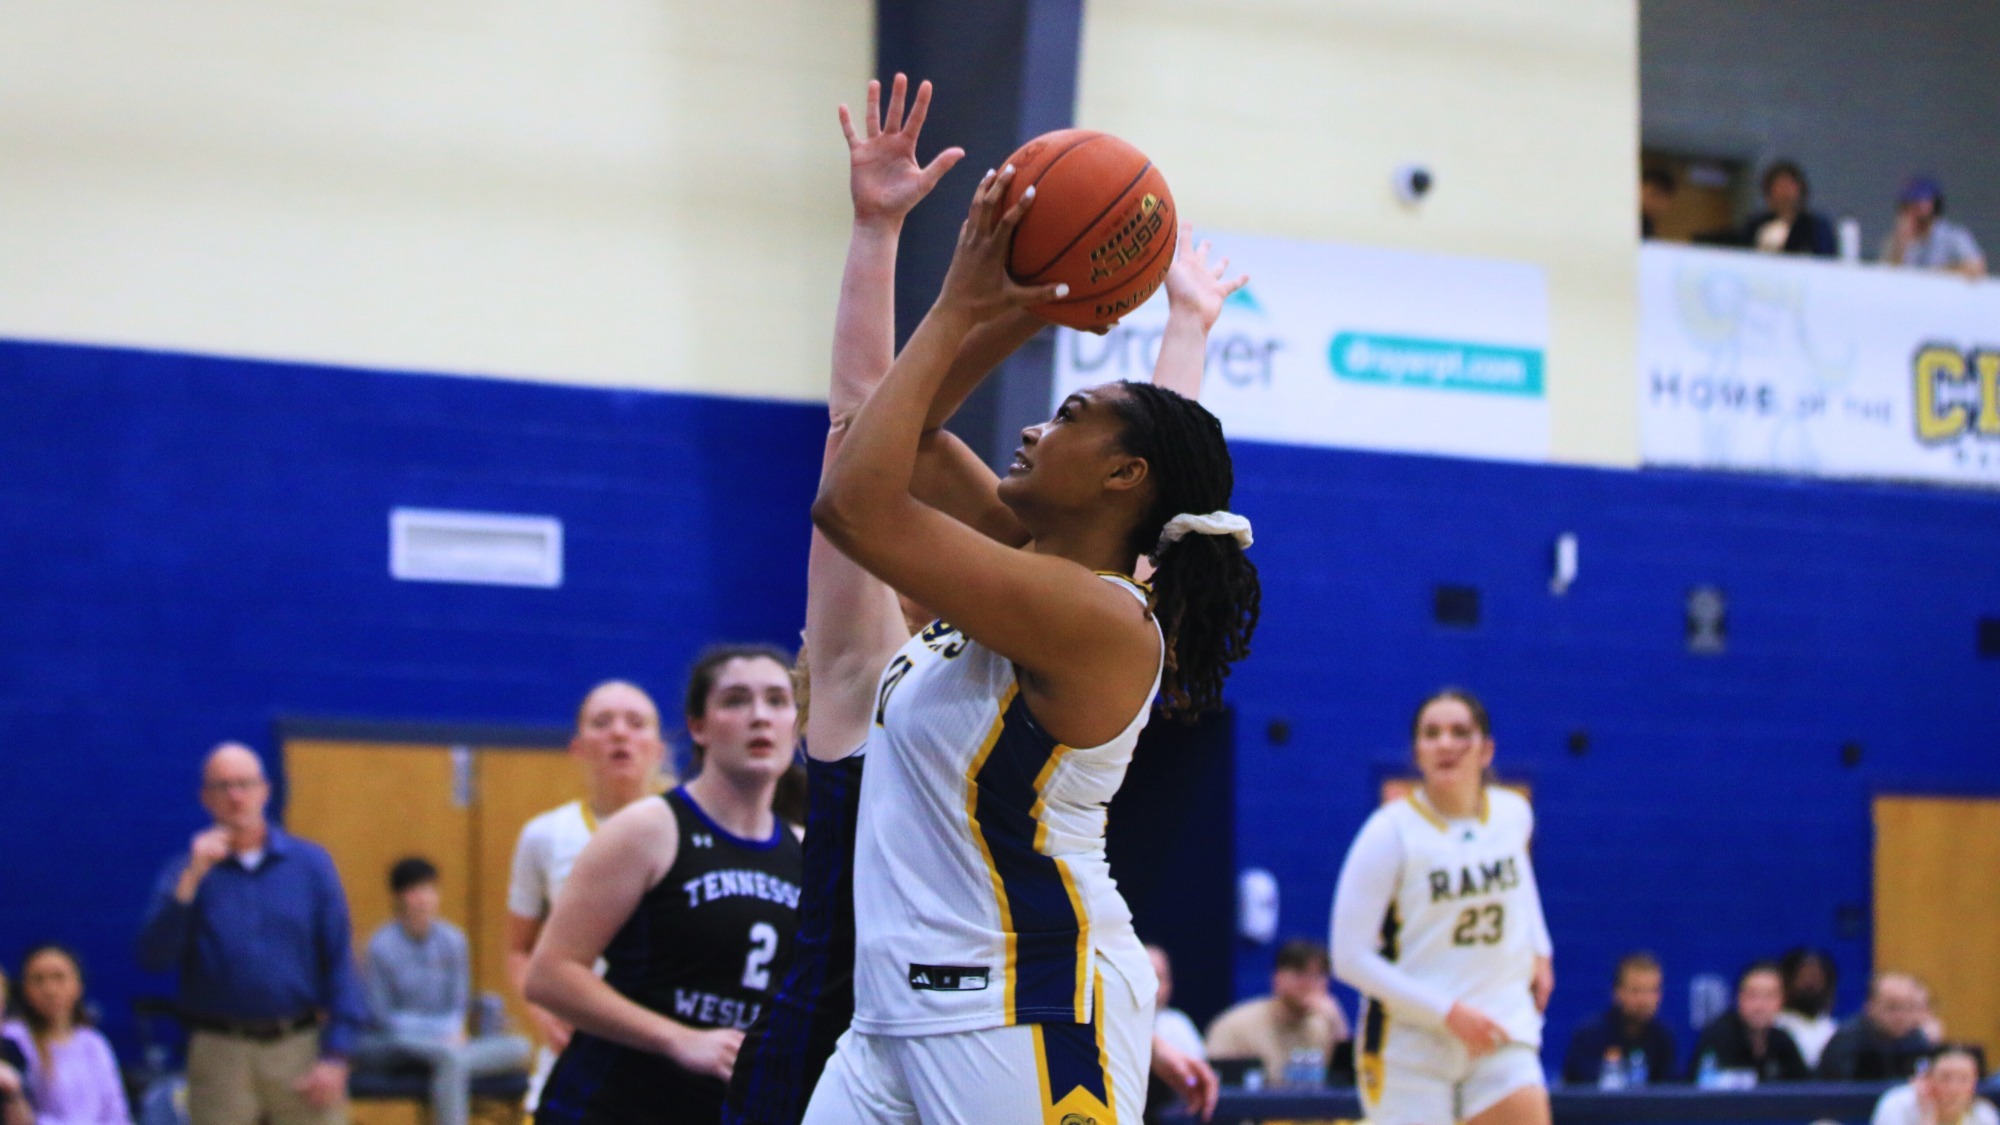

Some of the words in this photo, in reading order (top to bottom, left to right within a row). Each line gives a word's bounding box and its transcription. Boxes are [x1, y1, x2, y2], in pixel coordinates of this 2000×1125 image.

[1090, 198, 1169, 285] LEGACY
[1429, 857, 1520, 904] RAMS
[1453, 904, 1504, 946] 23
[742, 922, 779, 990] 2
